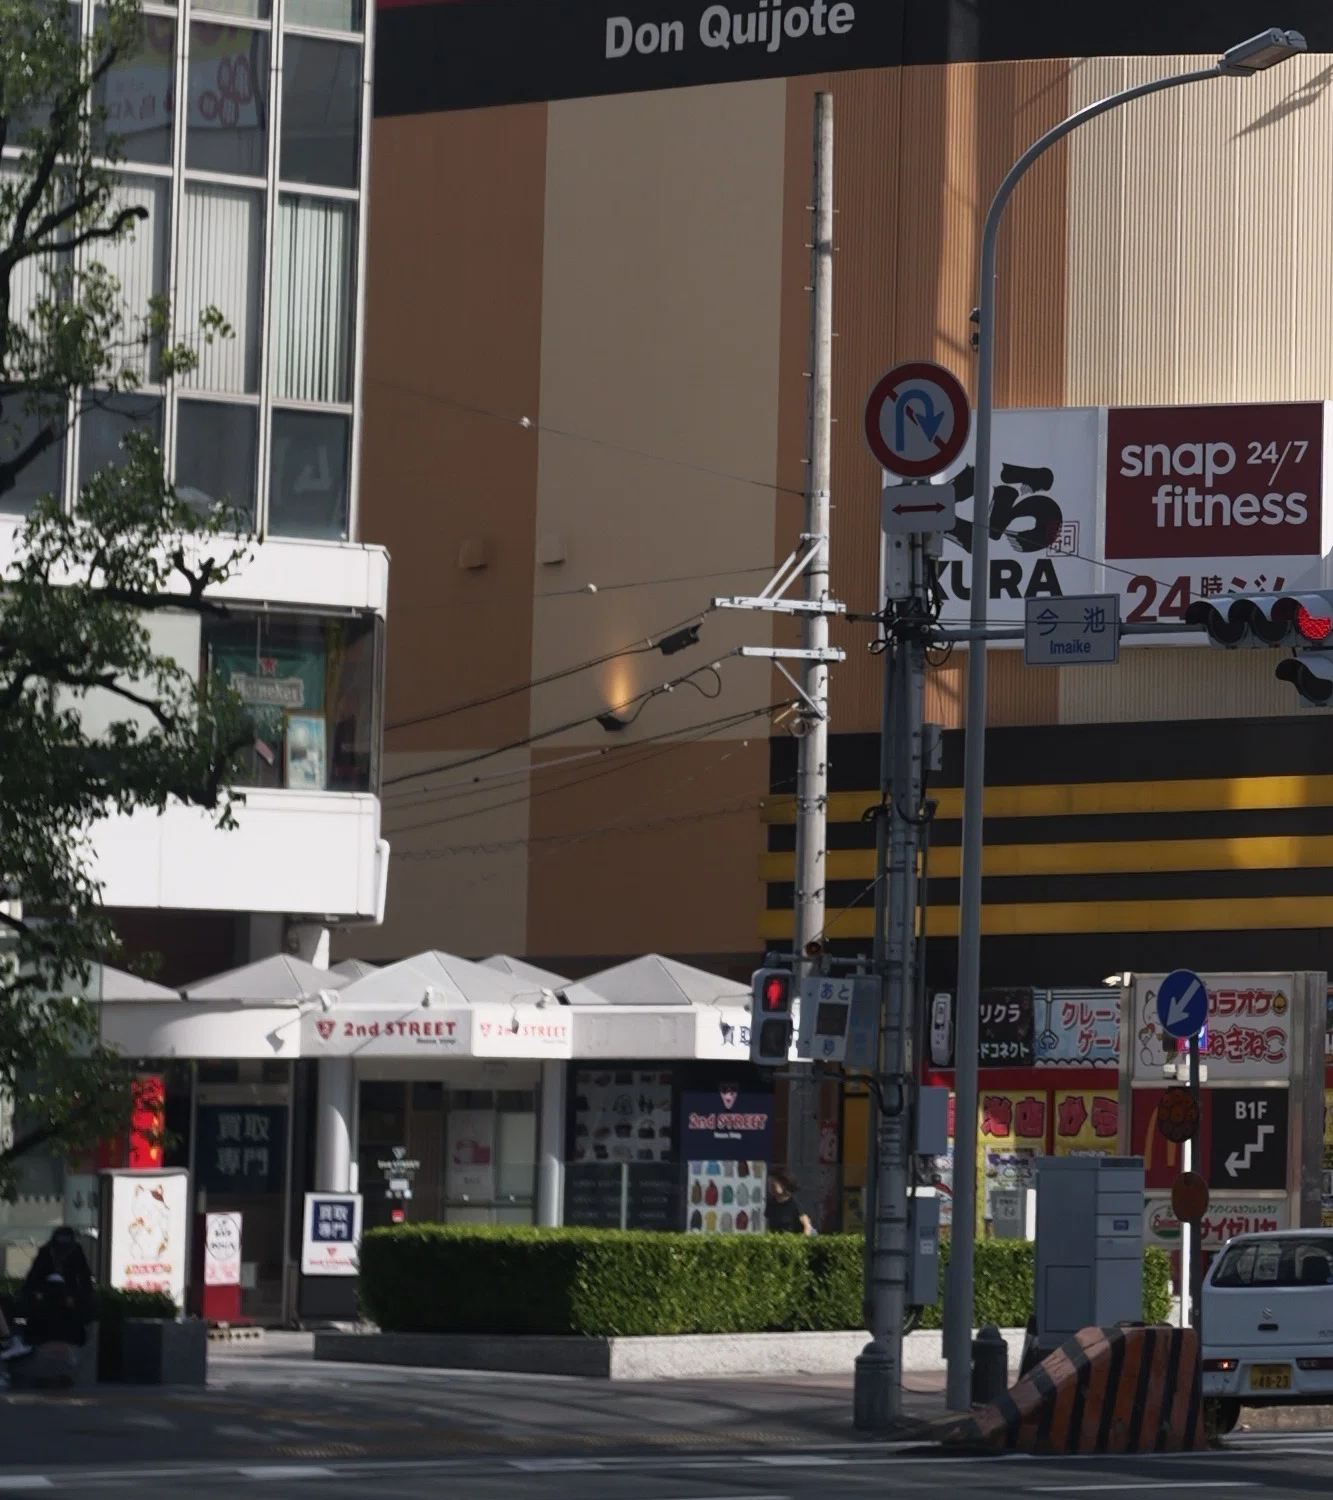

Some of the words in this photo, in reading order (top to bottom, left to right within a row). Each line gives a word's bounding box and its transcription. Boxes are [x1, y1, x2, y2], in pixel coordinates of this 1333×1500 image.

[605, 10, 684, 59] Don
[1120, 441, 1235, 488] snap
[1246, 440, 1308, 486] 24/7
[1152, 484, 1308, 528] fitness
[1035, 607, 1106, 636] 今池
[1049, 639, 1091, 656] Imaike
[819, 983, 849, 999] あと
[1061, 1002, 1121, 1030] クレー
[344, 1021, 379, 1036] 2nd
[387, 1021, 456, 1036] STREET
[524, 1026, 567, 1037] STREET
[979, 1042, 1029, 1059] ドコネクト
[1207, 1025, 1288, 1063] ねきねこ
[718, 1113, 768, 1130] STREET
[1235, 1101, 1267, 1119] B1F
[218, 1113, 270, 1141] 買取
